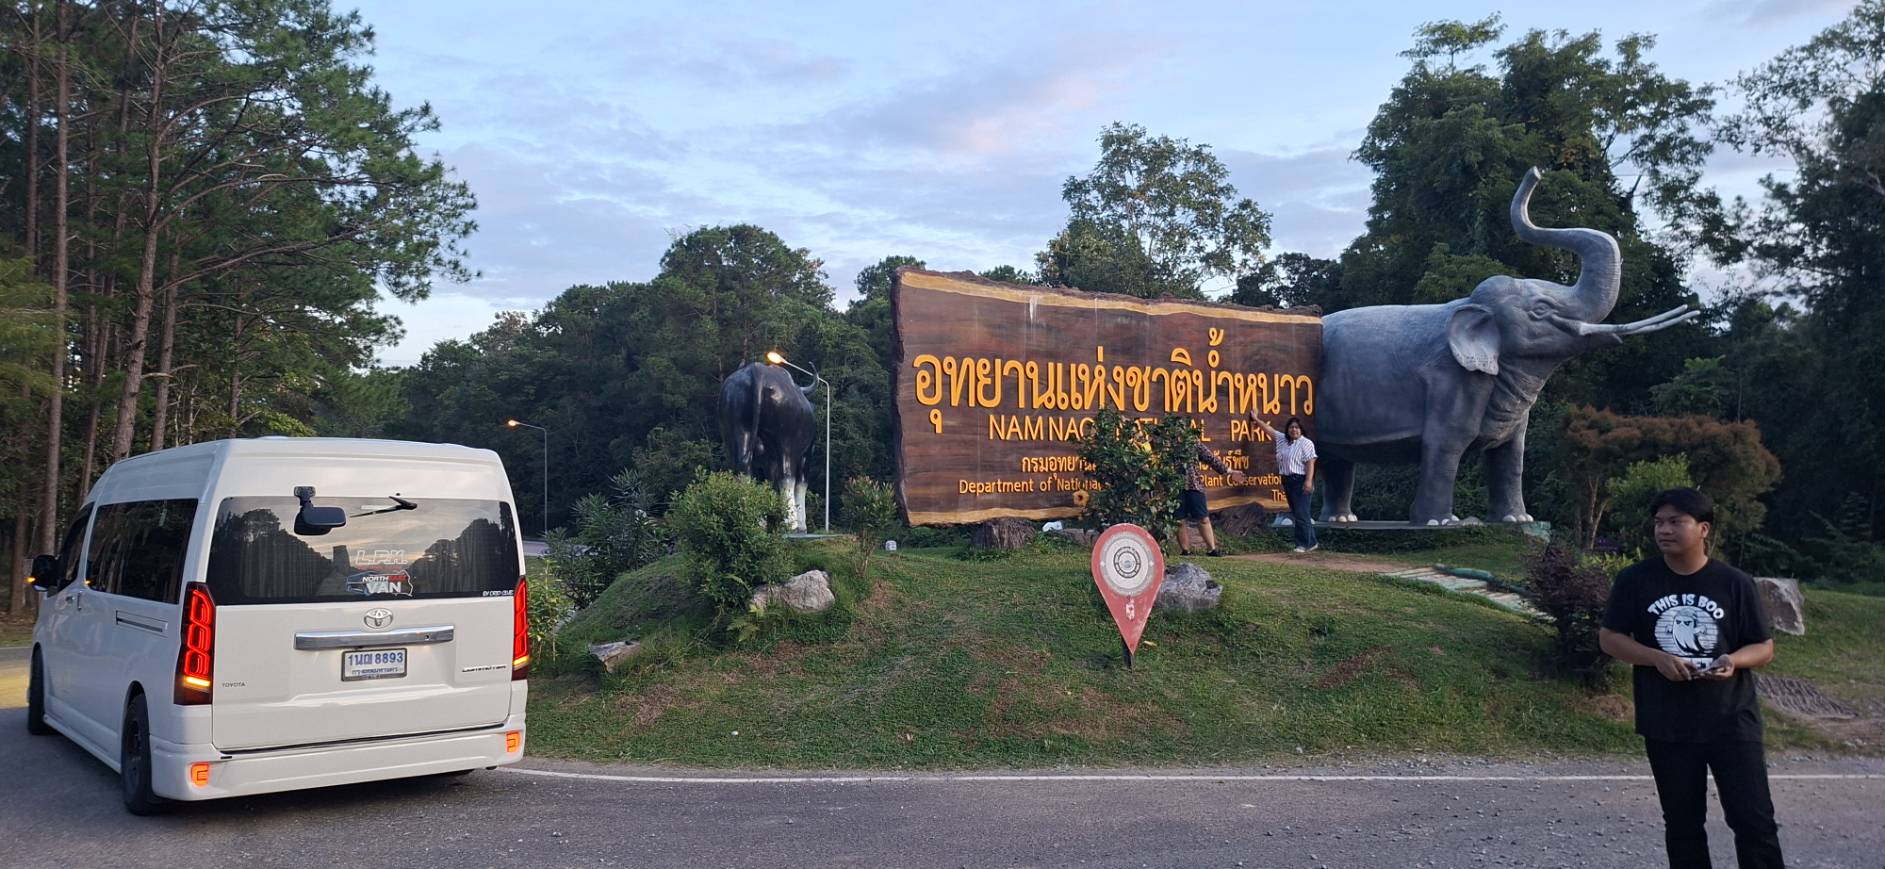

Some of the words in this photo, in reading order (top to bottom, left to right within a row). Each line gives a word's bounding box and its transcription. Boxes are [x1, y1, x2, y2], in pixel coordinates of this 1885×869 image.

[913, 326, 1313, 434] อุทยานแห่งชาติน้ำหนาว
[988, 414, 1044, 441] NAM
[959, 478, 1034, 496] Department
[1039, 476, 1053, 492] of
[1226, 473, 1282, 487] Cservatio
[366, 581, 402, 594] VAN
[1647, 594, 1679, 616] THIS
[1682, 593, 1695, 607] IS
[1697, 595, 1725, 620] BOO
[374, 651, 404, 665] 8893
[222, 680, 247, 688] TOYOTA
